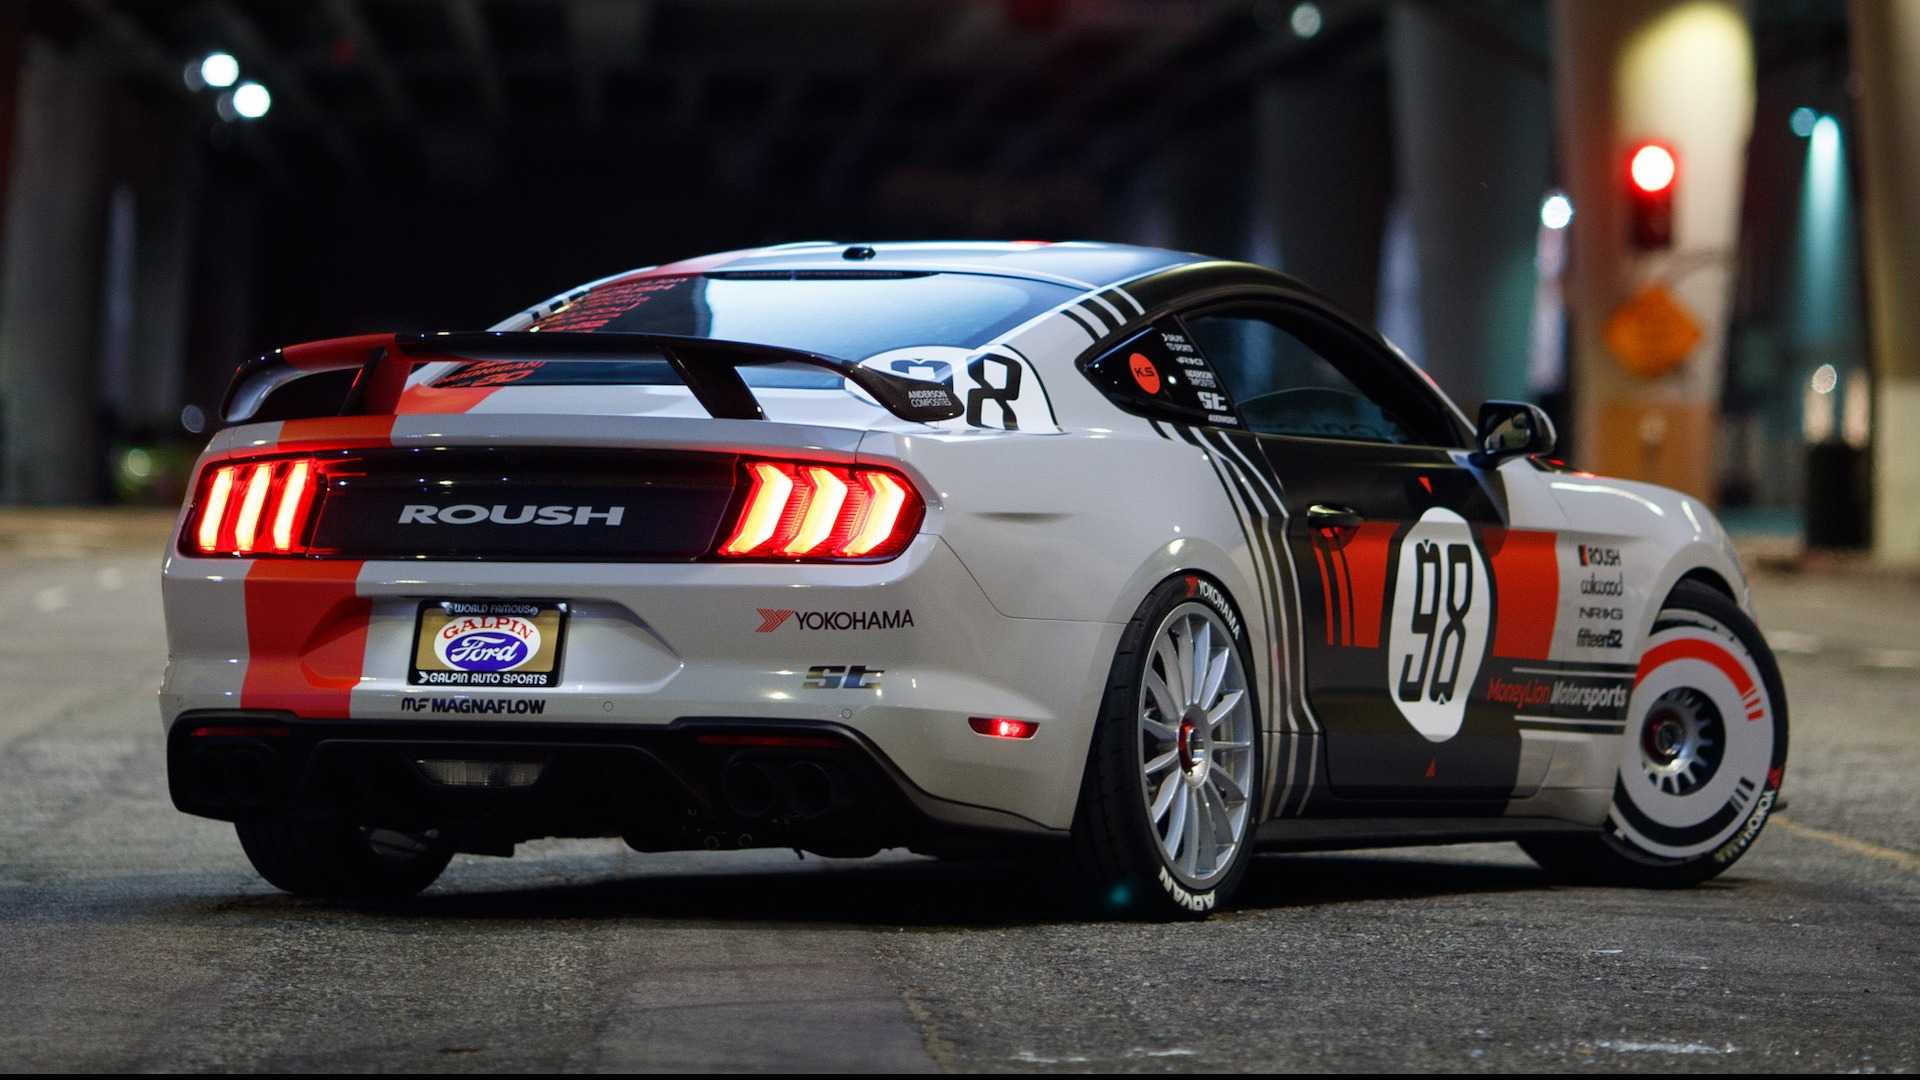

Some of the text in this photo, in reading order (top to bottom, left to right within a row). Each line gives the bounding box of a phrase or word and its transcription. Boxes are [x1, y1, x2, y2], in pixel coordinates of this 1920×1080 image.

[908, 390, 948, 399] ANDERSON
[911, 398, 953, 408] COMPOSITES
[398, 504, 625, 526] ROUSH
[1588, 547, 1622, 567] ROUSH
[454, 602, 531, 615] WORLD FAMOUS
[795, 608, 915, 631] YOKOHAMA
[1197, 579, 1241, 640] YOKOHAMA
[442, 615, 534, 641] GALPIN
[1398, 540, 1473, 703] 98
[449, 635, 521, 663] Ford
[429, 672, 548, 686] GALPIN AUTO SPORTS
[430, 697, 547, 715] MAGNAFLOW
[1487, 678, 1628, 712] MoneyLion Motorsports
[1159, 865, 1216, 912] ADVAN
